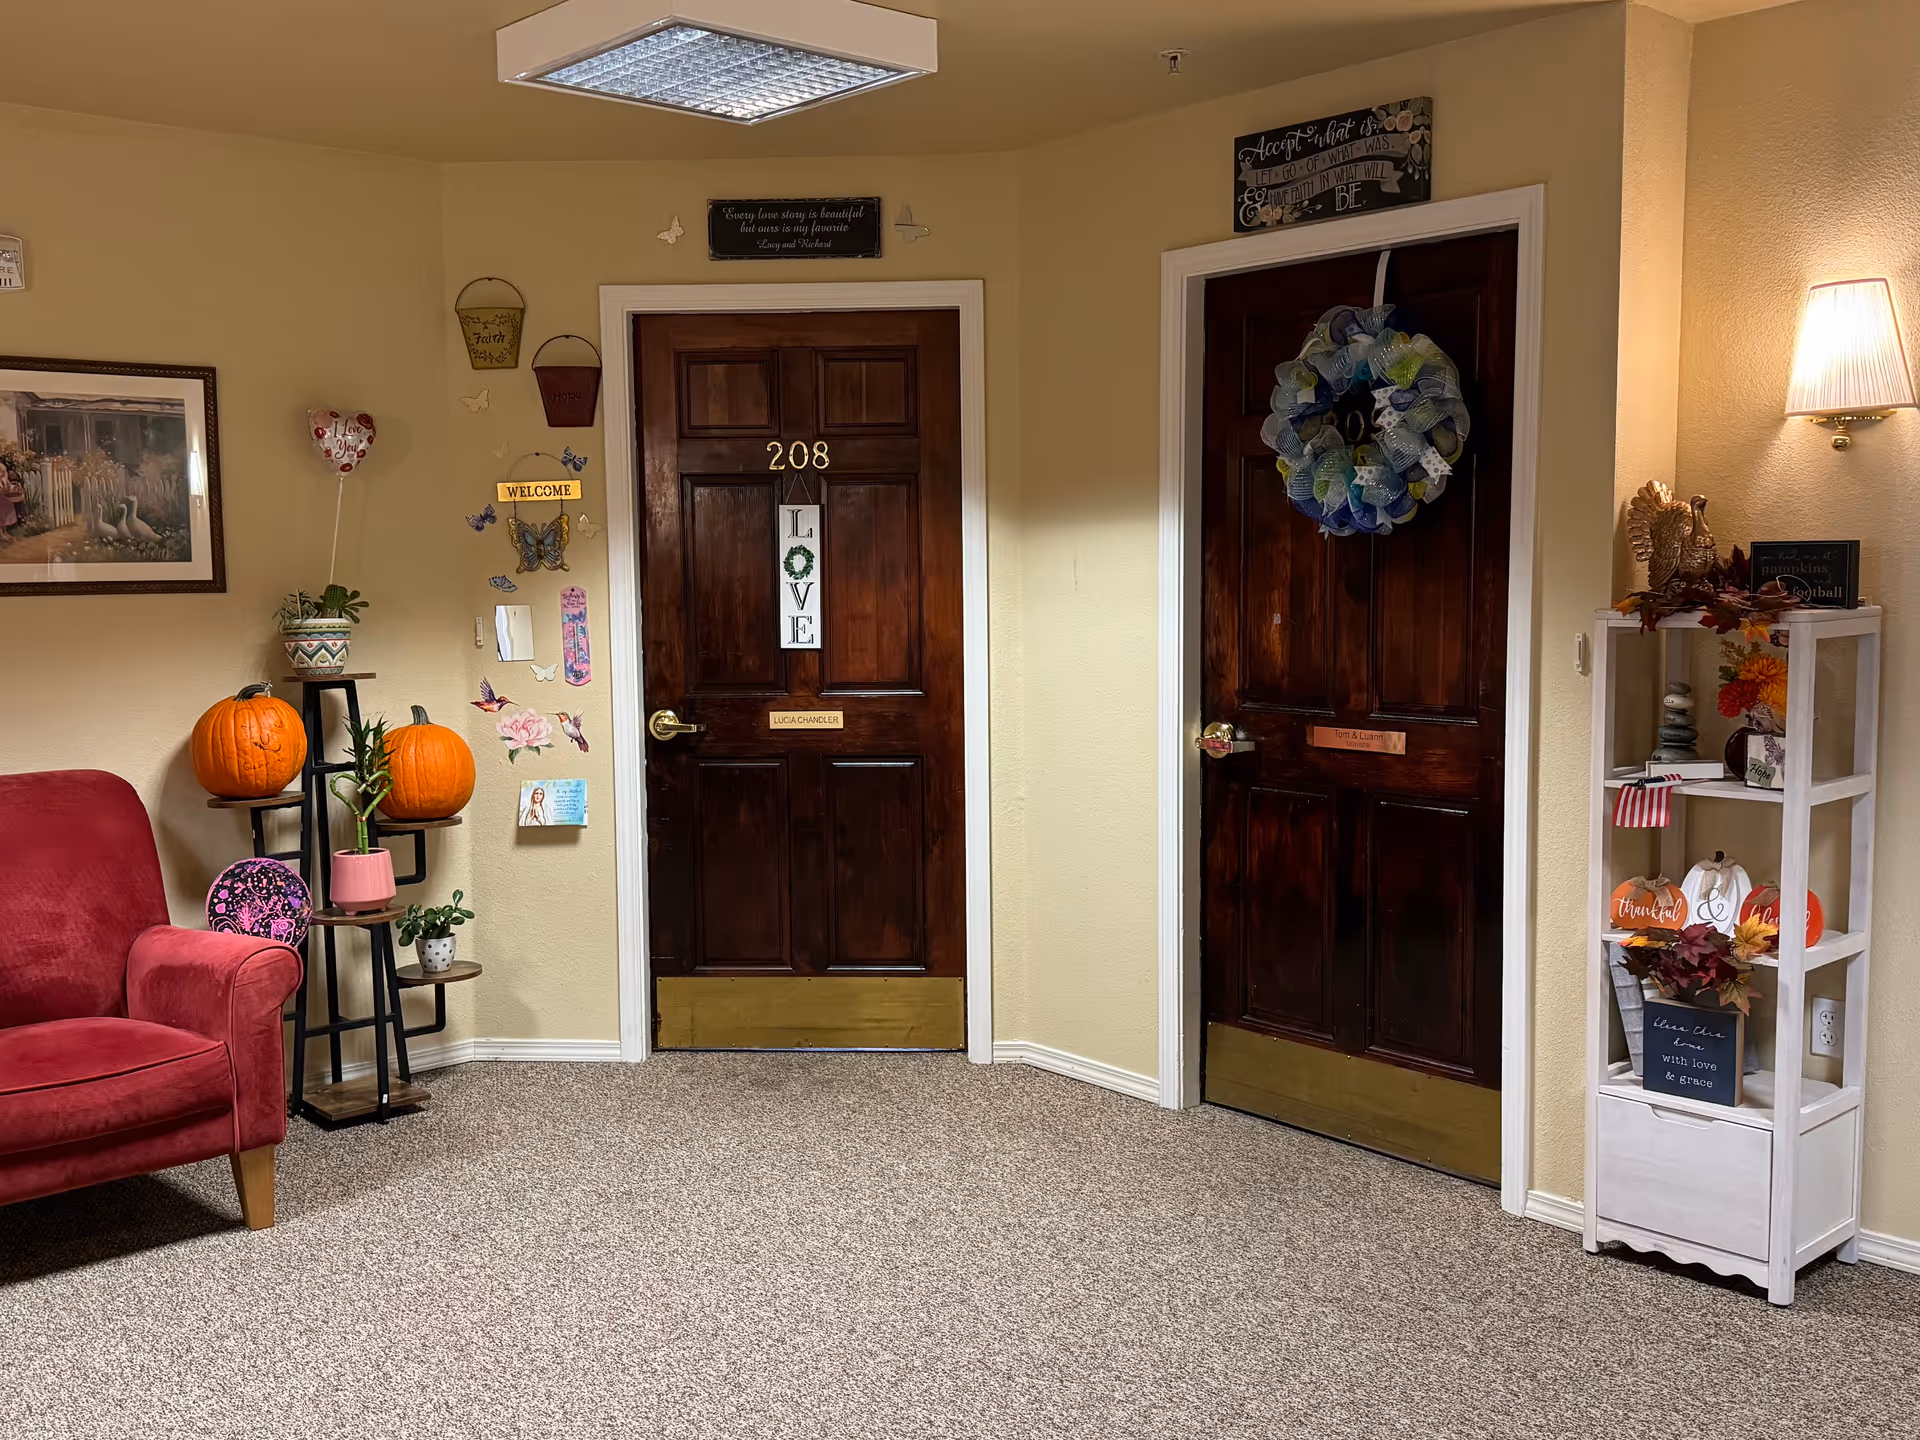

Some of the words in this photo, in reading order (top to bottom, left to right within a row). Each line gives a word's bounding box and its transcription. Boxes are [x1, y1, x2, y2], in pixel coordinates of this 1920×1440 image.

[1238, 126, 1318, 164] Accept
[1308, 118, 1356, 148] what
[1256, 169, 1273, 186] LET
[1282, 163, 1297, 181] GO
[1306, 156, 1320, 173] OF
[1328, 142, 1356, 165] WHAT
[1268, 189, 1291, 207] HAVE
[1291, 180, 1314, 203] FAITH
[1320, 172, 1330, 191] IN
[1334, 163, 1360, 184] WHAT
[1363, 162, 1388, 179] WILL
[722, 207, 756, 224] Every
[757, 207, 779, 220] love
[780, 209, 807, 223] story
[808, 208, 818, 219] is
[820, 205, 866, 222] beautiful
[740, 221, 756, 233] but
[757, 223, 780, 233] ours
[781, 222, 792, 233] is
[793, 223, 809, 236] my
[810, 220, 850, 236] favorite
[757, 238, 781, 251] Lucy
[782, 239, 796, 249] and
[797, 238, 832, 249] Richard
[472, 331, 506, 345] Faith
[333, 420, 338, 438] I
[341, 419, 363, 438] Love
[334, 439, 359, 460] You
[766, 440, 830, 470] 208
[506, 484, 571, 498] WELCOME
[1792, 585, 1842, 598] football
[773, 716, 797, 725] LUCIA
[797, 715, 839, 724] CHANDLER
[1334, 729, 1350, 739] Tom
[1351, 730, 1358, 740] &
[1359, 731, 1385, 742] Luann
[1750, 763, 1772, 782] Hope
[1613, 897, 1683, 923] thankful
[1696, 886, 1729, 922] &
[1653, 1016, 1689, 1033] bless
[1693, 1025, 1726, 1039] this
[1673, 1037, 1705, 1051] home
[1662, 1054, 1688, 1067] with
[1692, 1058, 1717, 1072] love
[1665, 1071, 1675, 1081] &
[1679, 1075, 1713, 1089] grace
